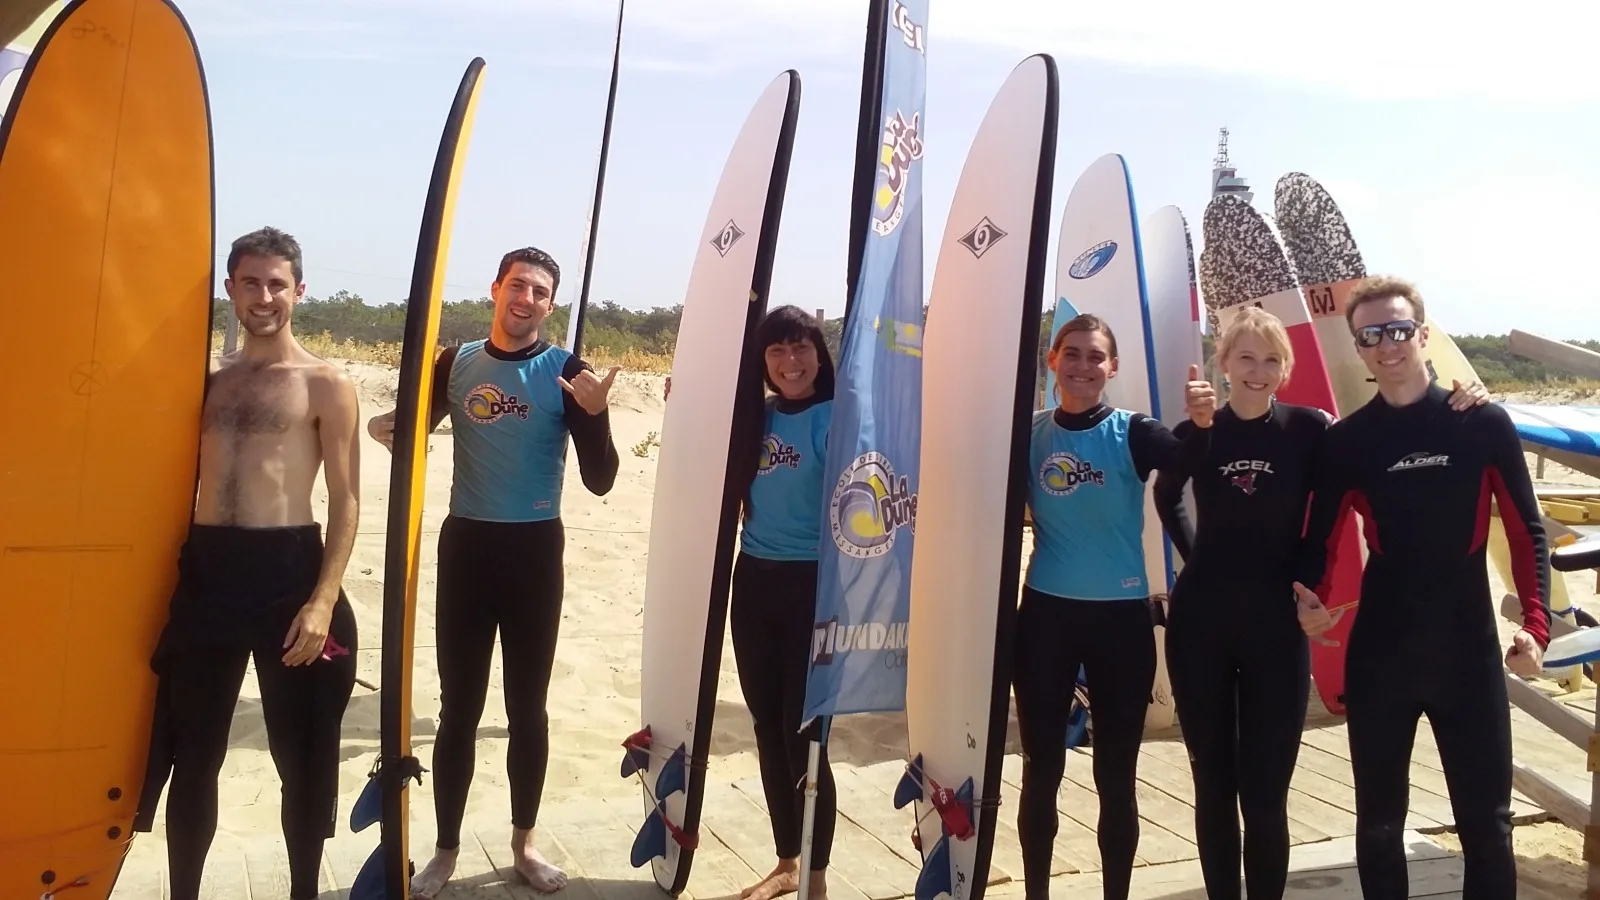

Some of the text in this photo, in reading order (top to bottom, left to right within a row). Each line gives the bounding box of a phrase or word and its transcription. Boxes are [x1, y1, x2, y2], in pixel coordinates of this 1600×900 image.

[500, 393, 518, 405] La
[490, 401, 529, 420] Dune
[778, 444, 794, 455] La
[769, 452, 801, 469] Dune
[1076, 461, 1092, 473] La
[1218, 459, 1275, 476] XCEL
[1392, 455, 1449, 468] ALDER
[1066, 470, 1104, 486] Dune
[888, 473, 909, 503] La
[880, 495, 918, 534] Dune
